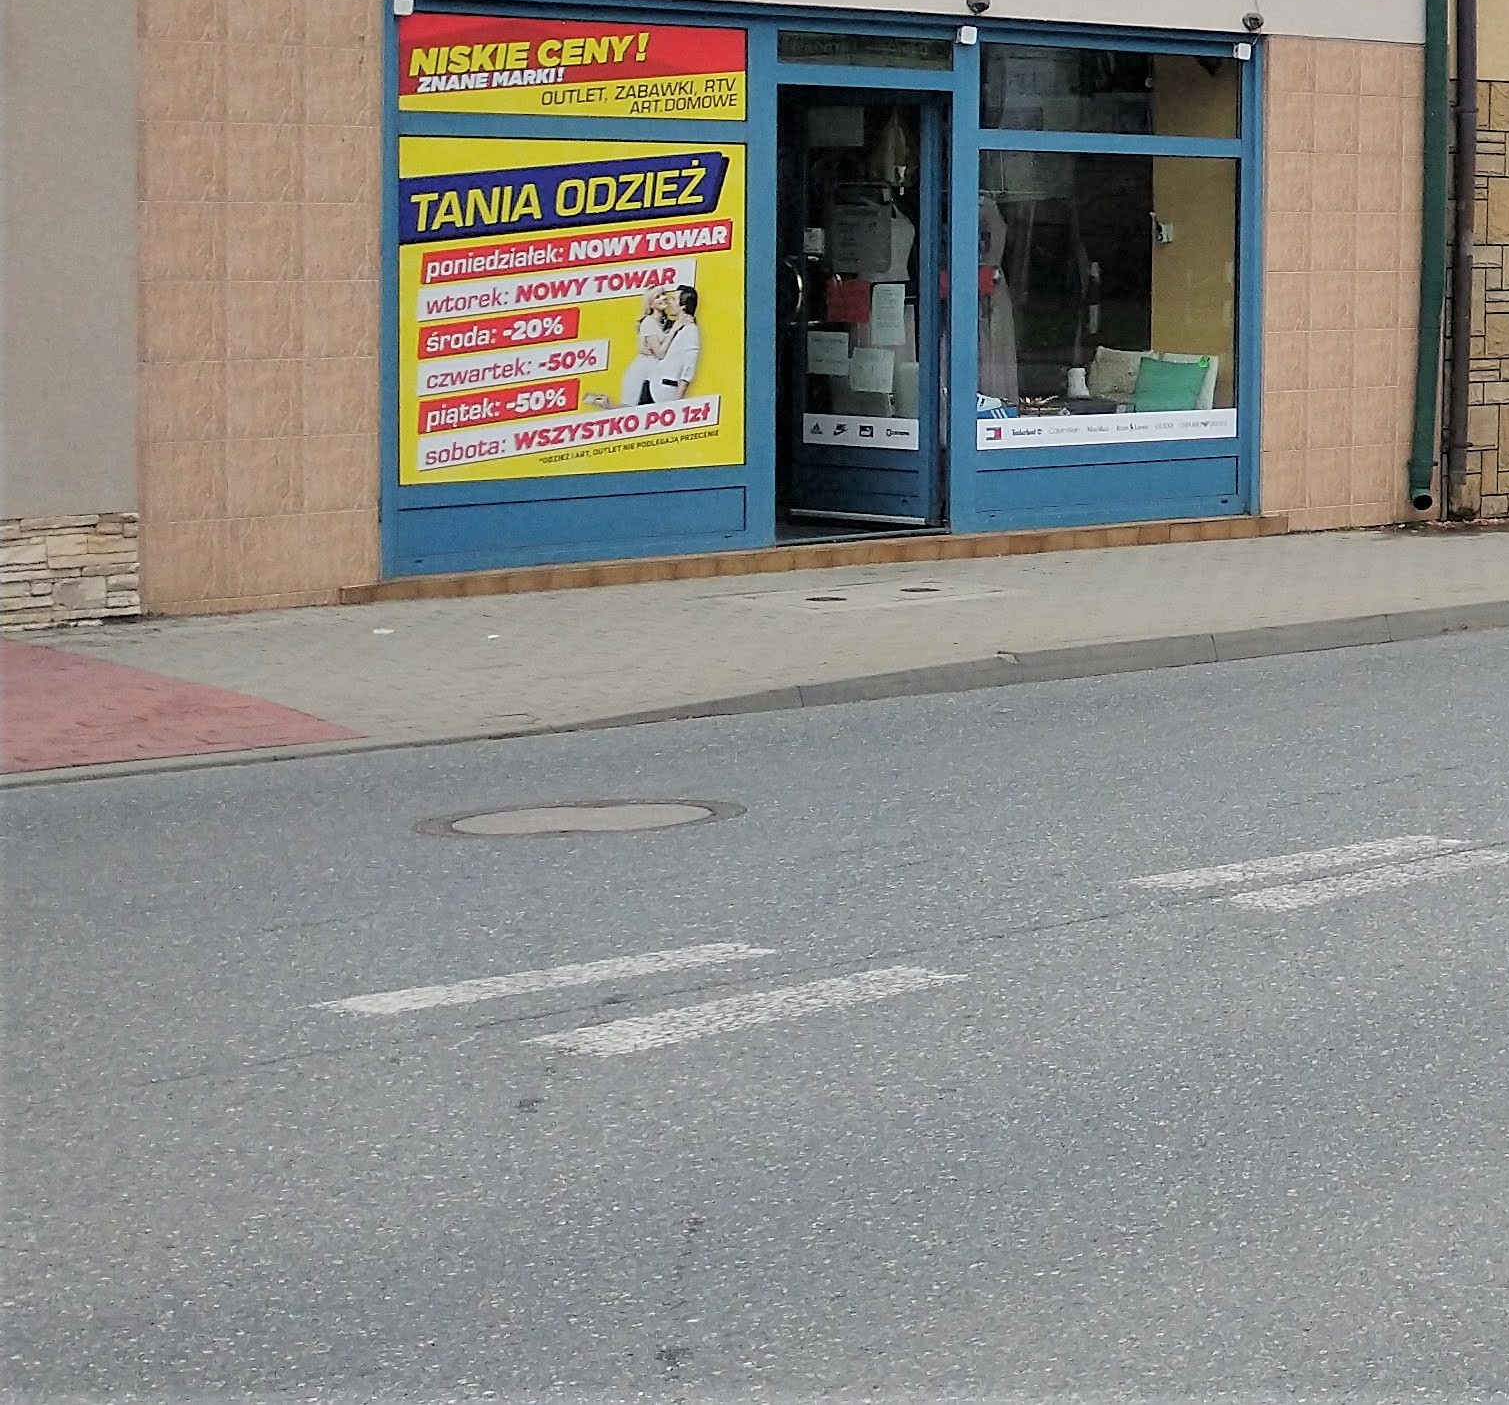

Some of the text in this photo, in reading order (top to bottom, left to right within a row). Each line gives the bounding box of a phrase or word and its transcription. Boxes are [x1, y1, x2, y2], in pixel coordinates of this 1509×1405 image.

[408, 41, 529, 77] NISKIE
[417, 67, 566, 92] ZNANE MARKI!
[541, 78, 736, 106] OUTLET, ZABAWKI, RTV
[410, 160, 707, 233] TANIA ODZIEŻ
[426, 226, 728, 284] poniedziałek: NOWY TOWAR
[426, 267, 677, 315] wtorek: NOWY TOWAR
[426, 316, 564, 353] środa: -20%
[426, 348, 597, 389] czwartek: -50%
[426, 387, 567, 432] piątek: -50%
[425, 403, 712, 467] sobota: WSZYSTKO PO 1zł
